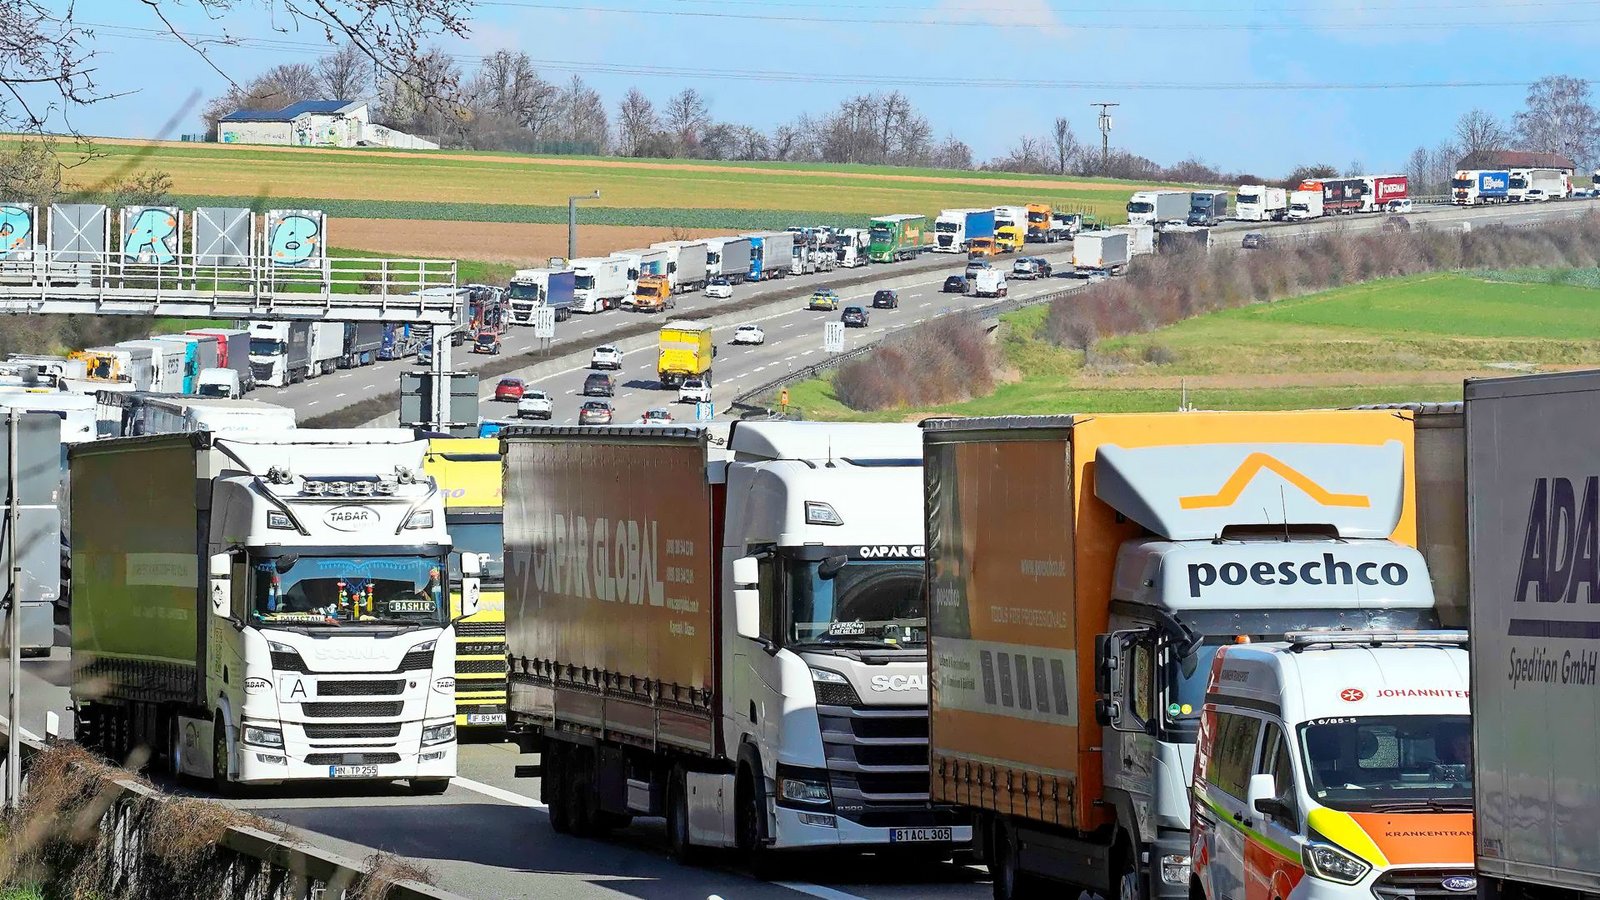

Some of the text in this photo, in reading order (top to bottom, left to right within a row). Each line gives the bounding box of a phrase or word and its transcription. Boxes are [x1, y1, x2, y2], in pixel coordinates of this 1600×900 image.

[331, 511, 369, 522] TABAR
[860, 545, 909, 558] QAPAR
[593, 513, 664, 607] GLOBAL
[1187, 553, 1409, 598] poeschco
[395, 602, 430, 612] BASHIR
[313, 646, 391, 661] SCANIA
[1508, 647, 1598, 690] Spedition GmbH
[290, 678, 307, 698] A
[334, 766, 377, 775] HN TP 255
